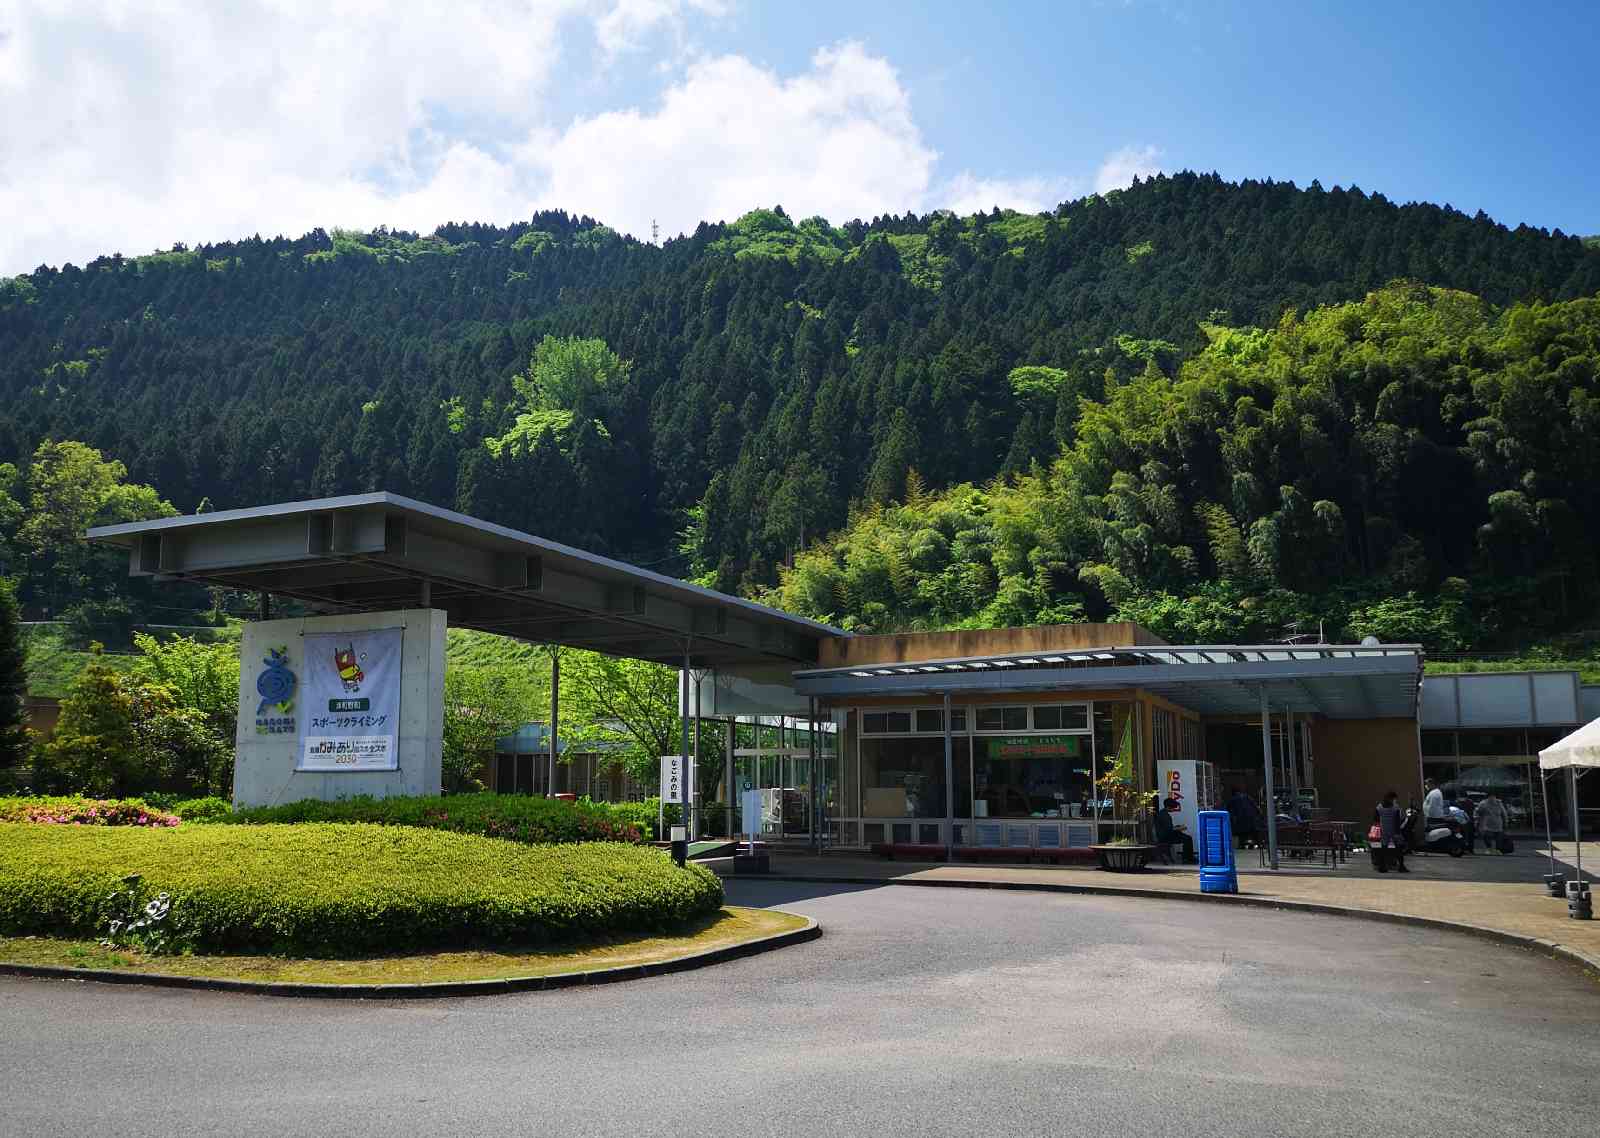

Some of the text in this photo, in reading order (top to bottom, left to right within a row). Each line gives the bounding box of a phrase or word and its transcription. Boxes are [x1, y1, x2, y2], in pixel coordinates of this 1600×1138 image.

[312, 715, 387, 728] スポーツクライミング
